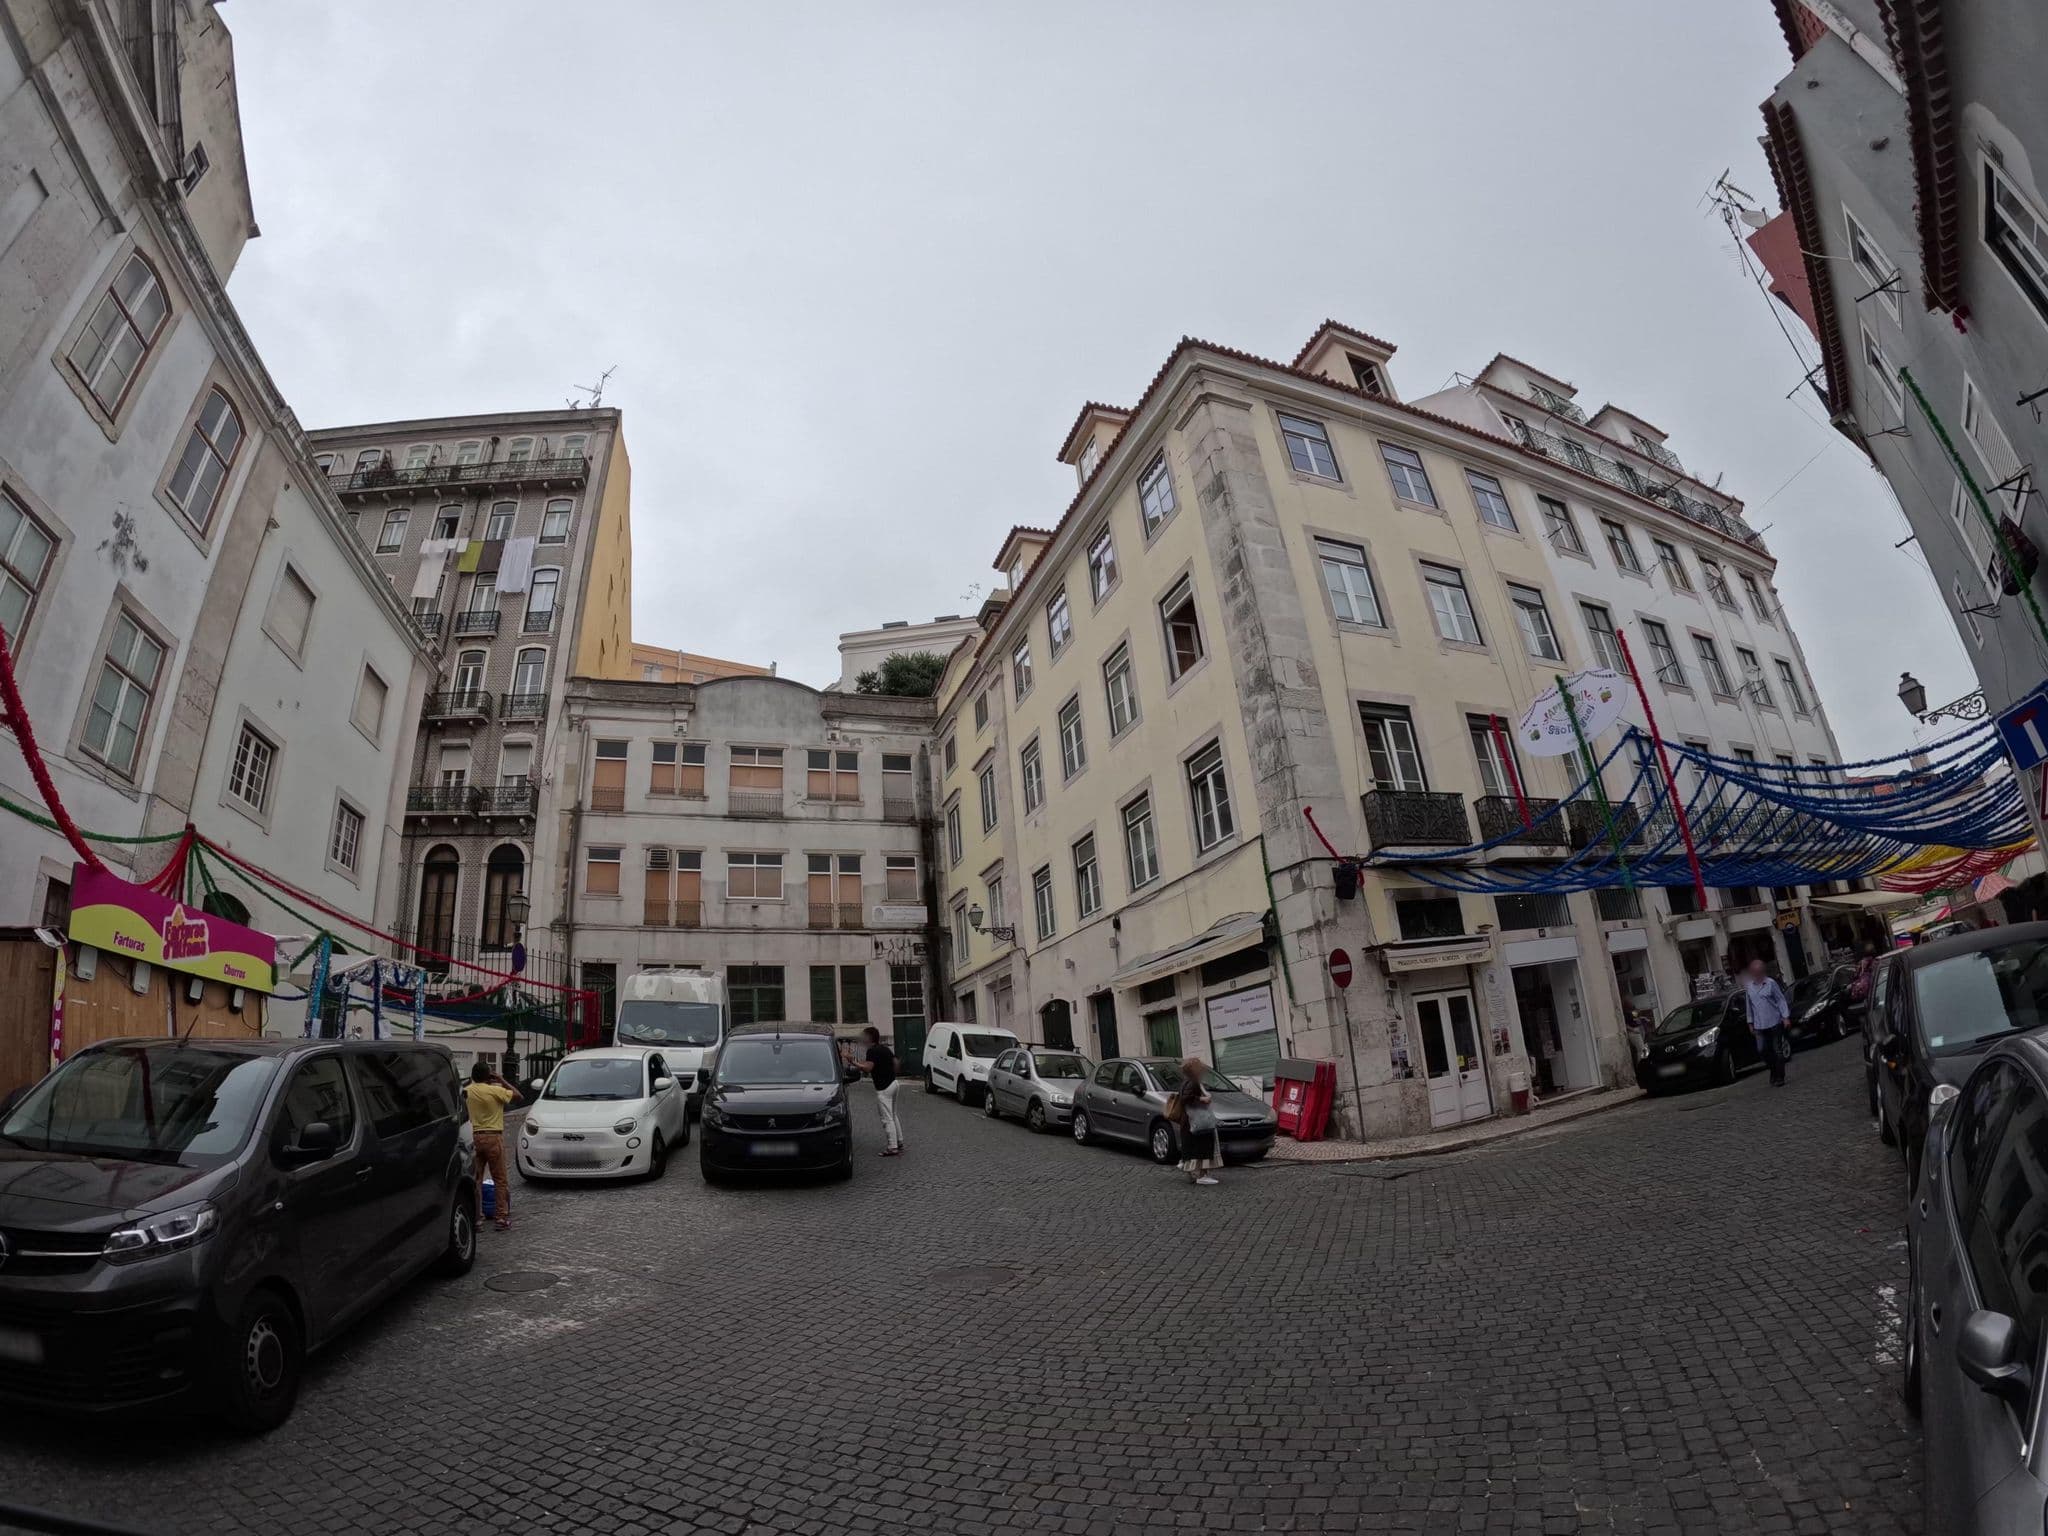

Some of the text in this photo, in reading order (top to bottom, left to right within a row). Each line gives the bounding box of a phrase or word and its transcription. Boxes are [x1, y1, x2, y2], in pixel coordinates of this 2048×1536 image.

[1547, 704, 1595, 735] São Mguel
[113, 931, 145, 952] Farturas
[224, 964, 246, 979] Churros
